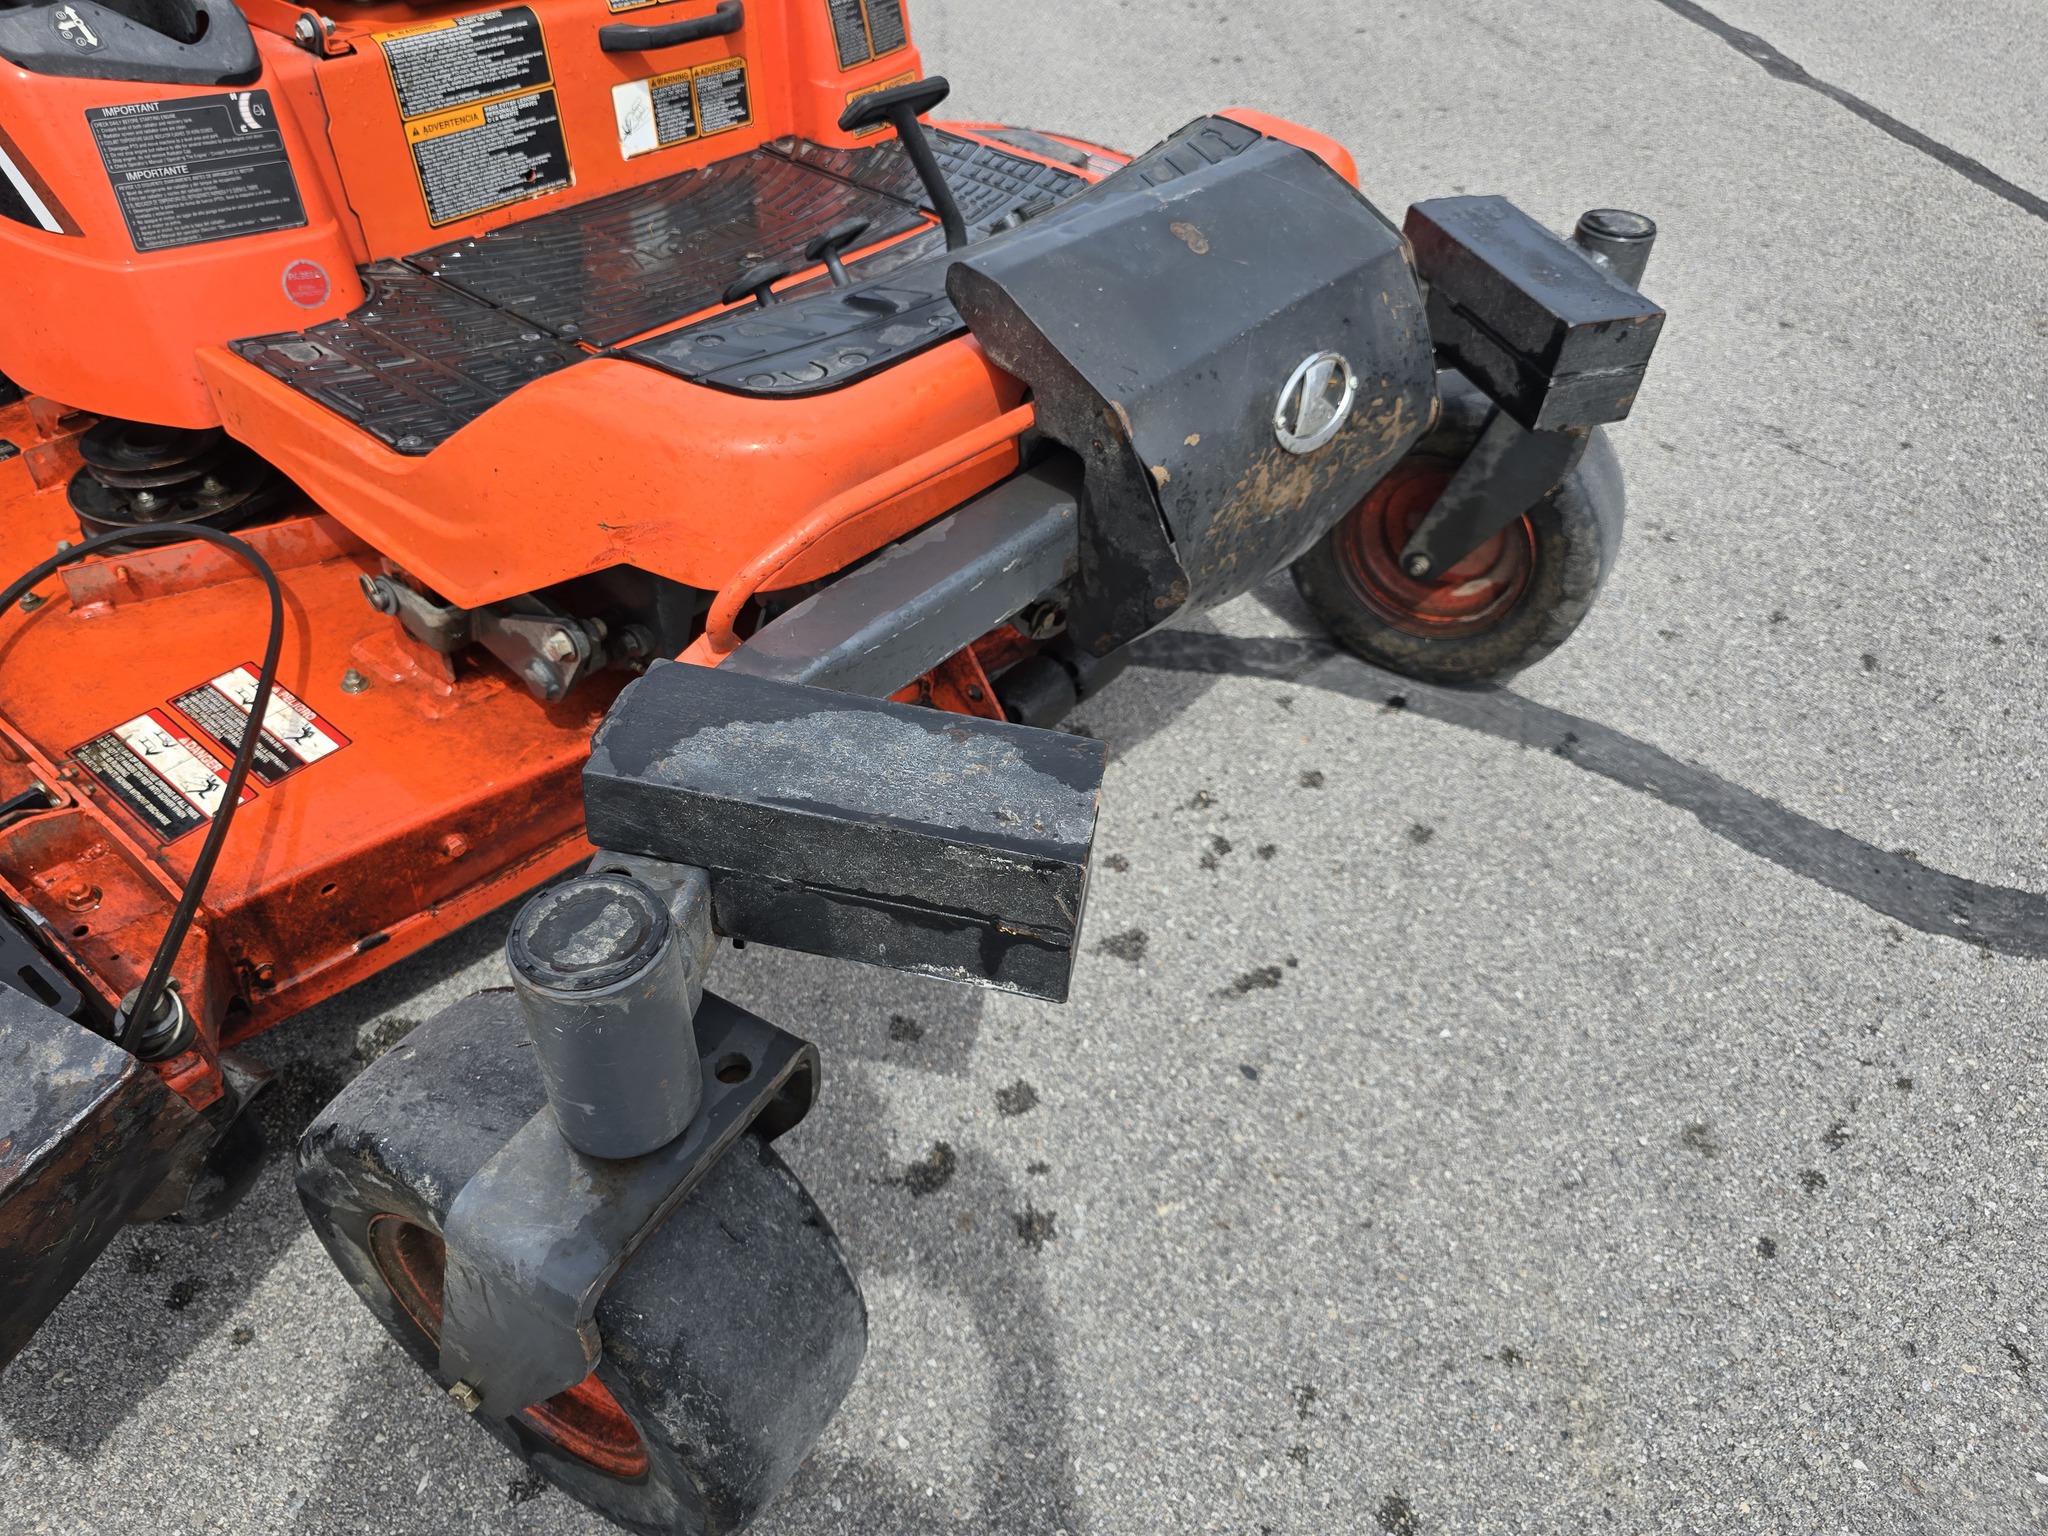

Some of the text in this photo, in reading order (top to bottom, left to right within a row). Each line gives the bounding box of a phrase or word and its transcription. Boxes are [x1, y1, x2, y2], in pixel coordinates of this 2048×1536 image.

[700, 60, 743, 75] ADVERTENCIA
[656, 72, 688, 85] WARNING
[102, 102, 160, 117] IMPORTANT
[240, 124, 248, 132] C
[423, 114, 479, 134] ADVERTENCIA
[126, 165, 189, 180] IMPORTANTE
[278, 691, 317, 720] PELIGRO
[182, 740, 224, 772] DANGER
